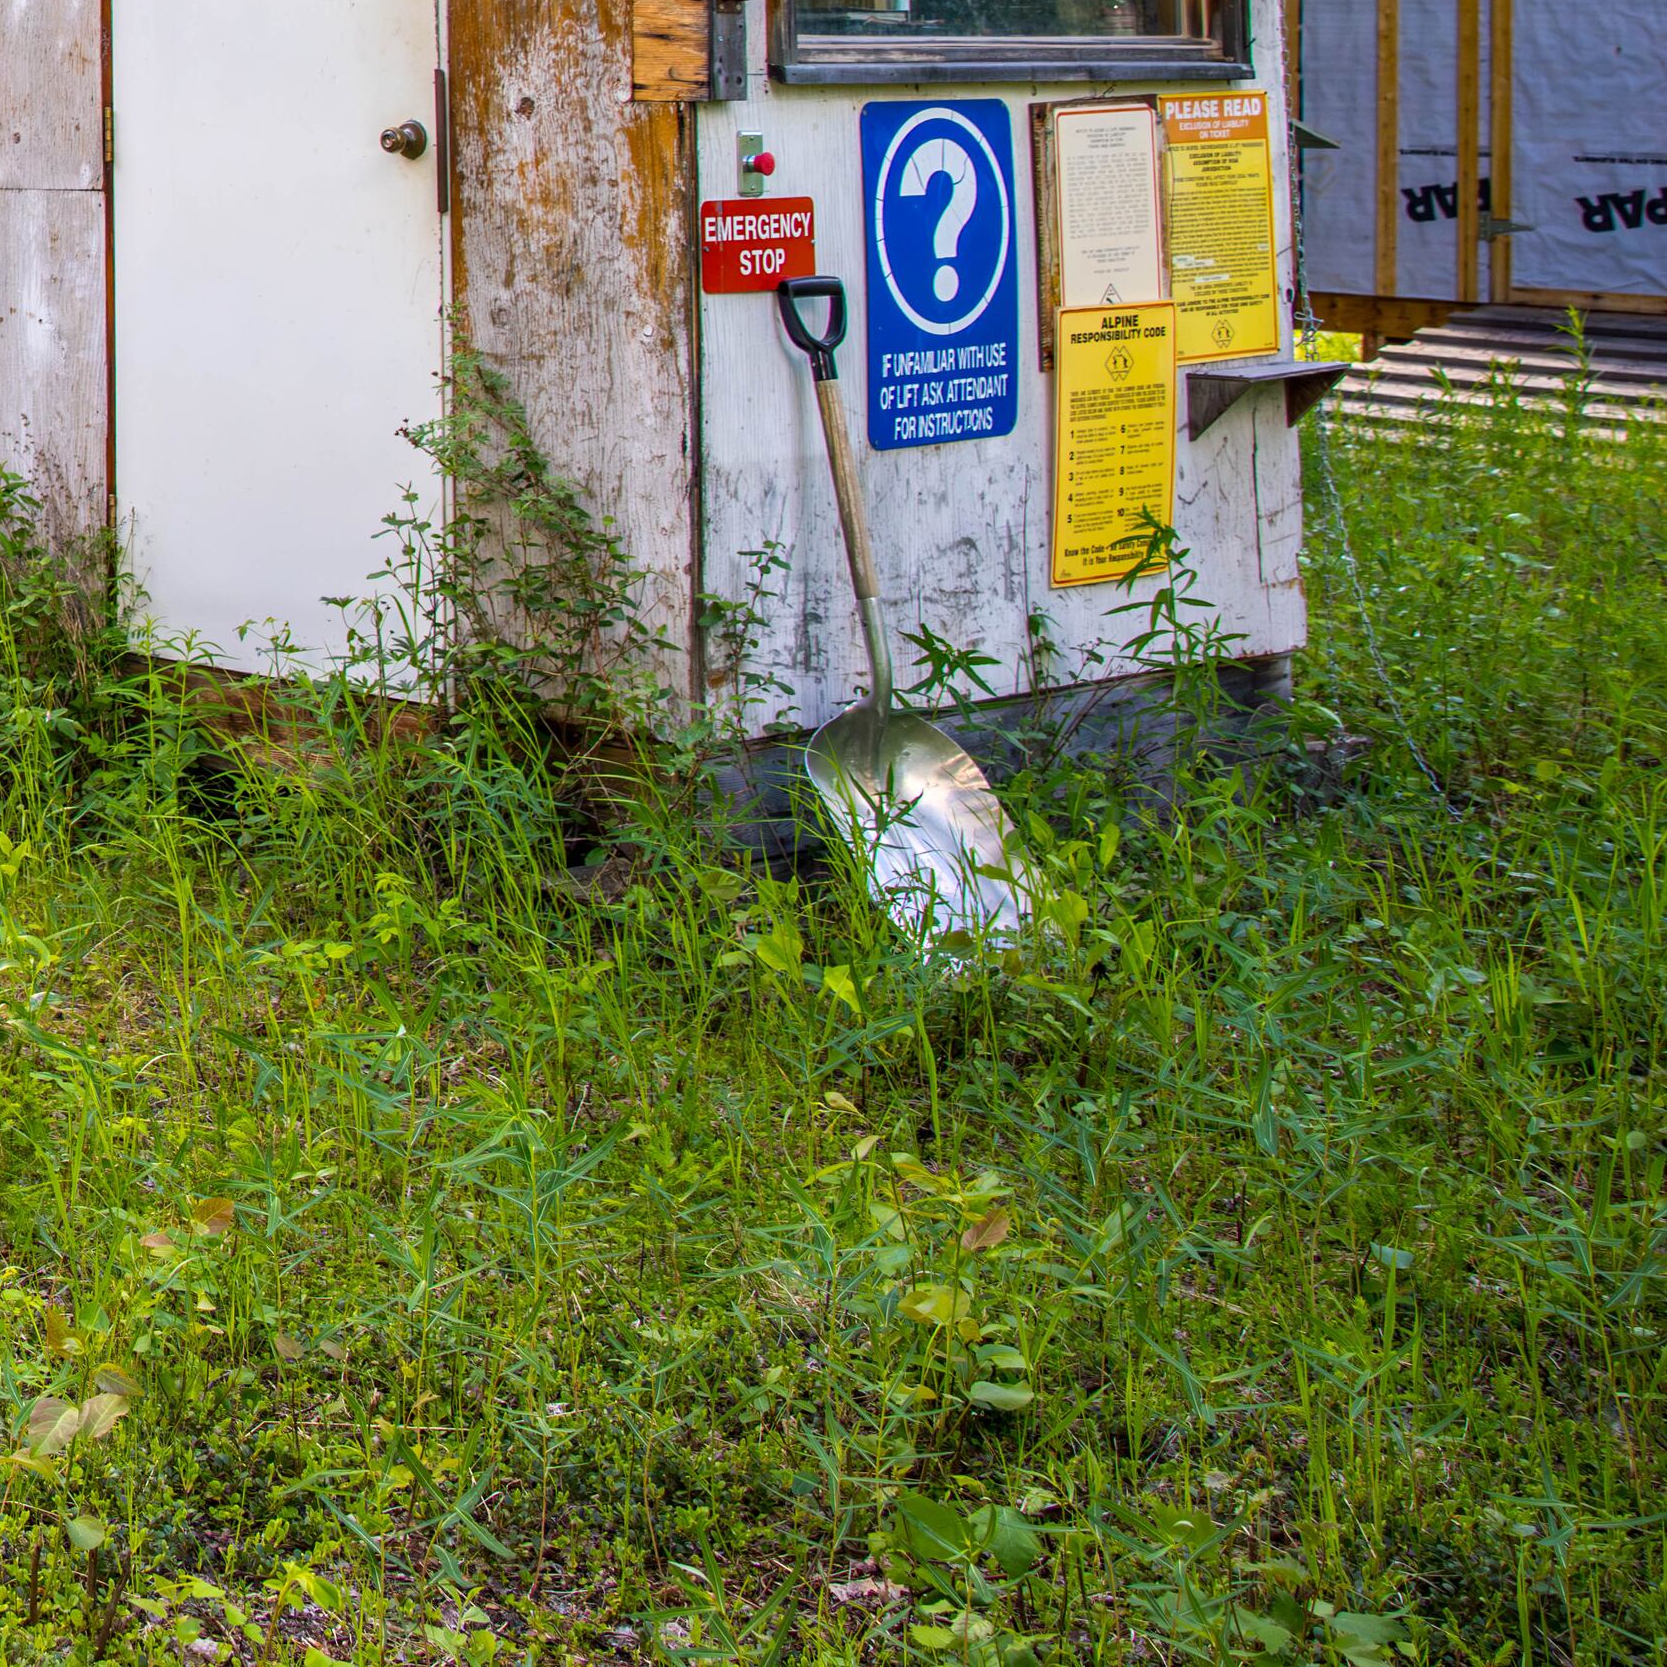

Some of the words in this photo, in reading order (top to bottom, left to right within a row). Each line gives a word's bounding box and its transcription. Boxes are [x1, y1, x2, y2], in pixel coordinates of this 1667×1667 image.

[1165, 100, 1219, 120] PLEASE
[1223, 98, 1261, 117] READ
[705, 212, 811, 242] EMERGENCY
[740, 248, 785, 275] STOP
[1101, 315, 1138, 329] ALPINE
[1071, 329, 1141, 344] RESPONSIBILITY
[1144, 327, 1166, 337] CODE
[883, 354, 892, 377] IF
[894, 349, 955, 376] UNFAMILIAR
[957, 346, 984, 370] WITH
[986, 342, 1007, 367] USE
[880, 386, 895, 410] OF
[897, 384, 919, 408] LIFT
[921, 382, 944, 406] ASK
[946, 374, 1008, 402] ATTENDANT
[894, 416, 916, 440] FOR
[918, 407, 993, 438] INSTRUCTIONS
[1120, 445, 1125, 454] 7
[1069, 452, 1074, 460] 2
[1120, 466, 1124, 475] 8
[1069, 472, 1073, 481] 3
[1119, 487, 1124, 496] 9
[1068, 493, 1073, 502] 4
[1117, 508, 1124, 516] 10
[1091, 545, 1104, 553] Code
